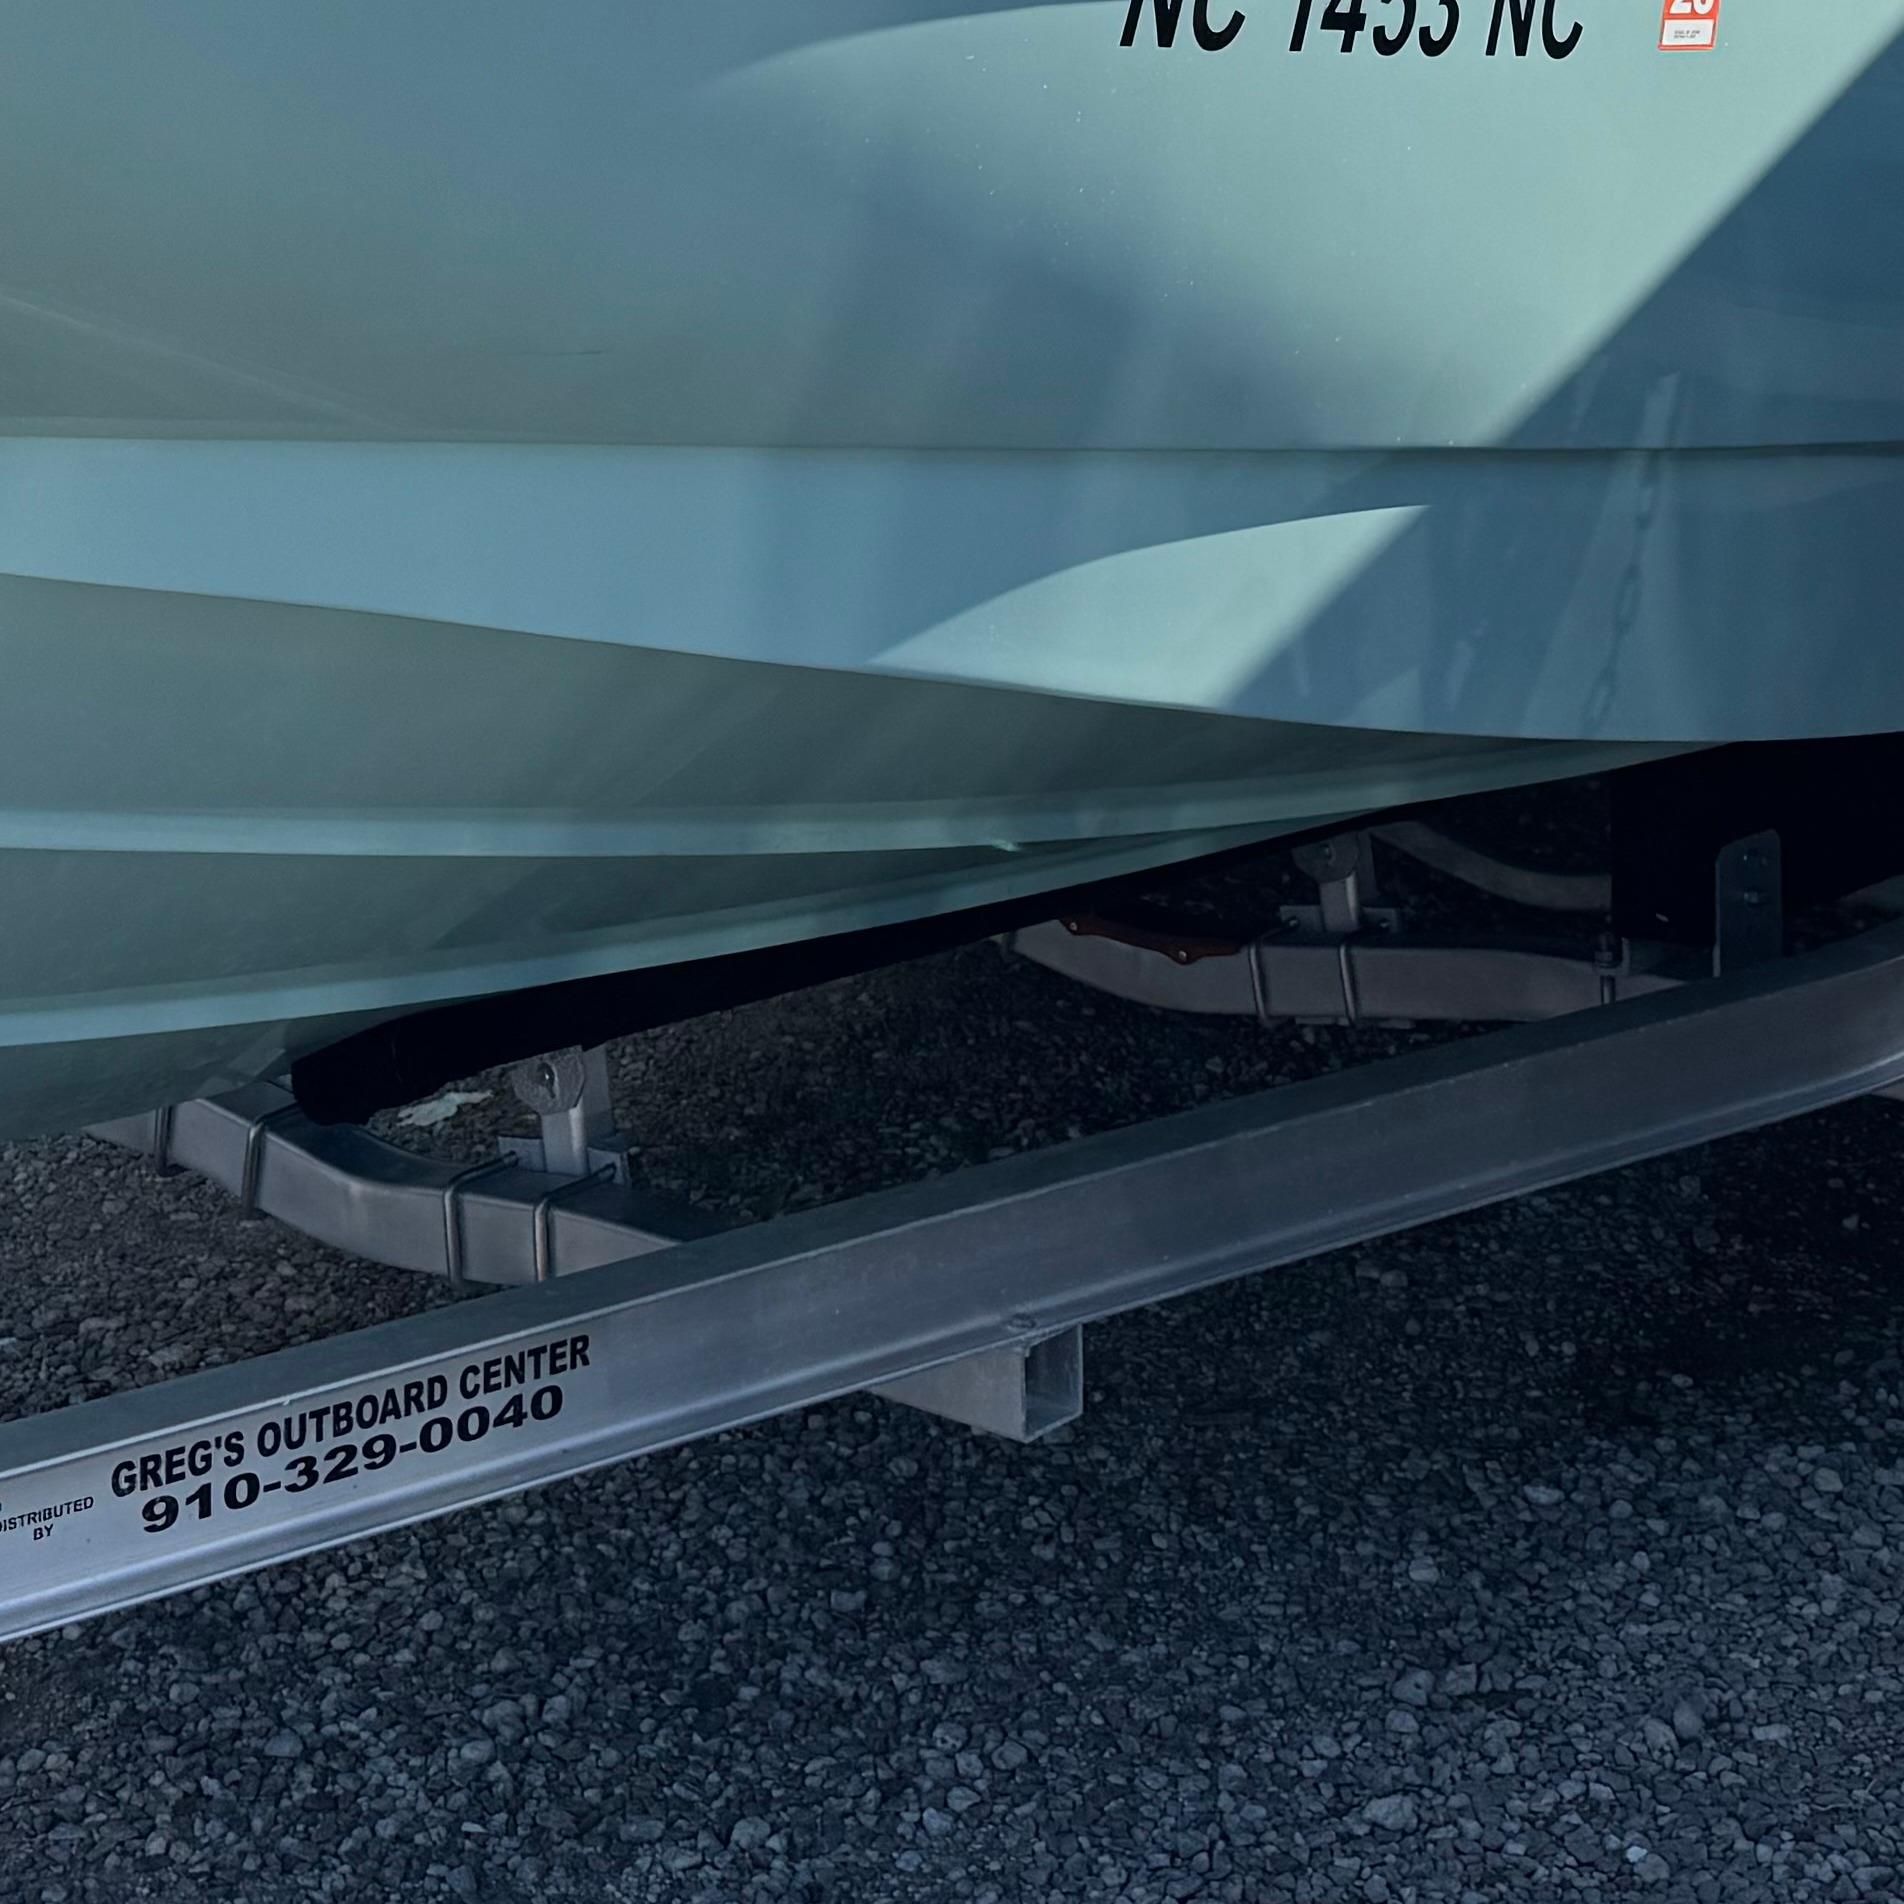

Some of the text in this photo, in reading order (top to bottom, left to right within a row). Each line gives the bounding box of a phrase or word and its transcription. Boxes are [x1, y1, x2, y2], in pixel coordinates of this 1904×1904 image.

[110, 1333, 591, 1498] GREG'S OUTBOARD CENTER
[140, 1384, 564, 1534] 910-329-0040
[33, 1523, 54, 1541] BY
